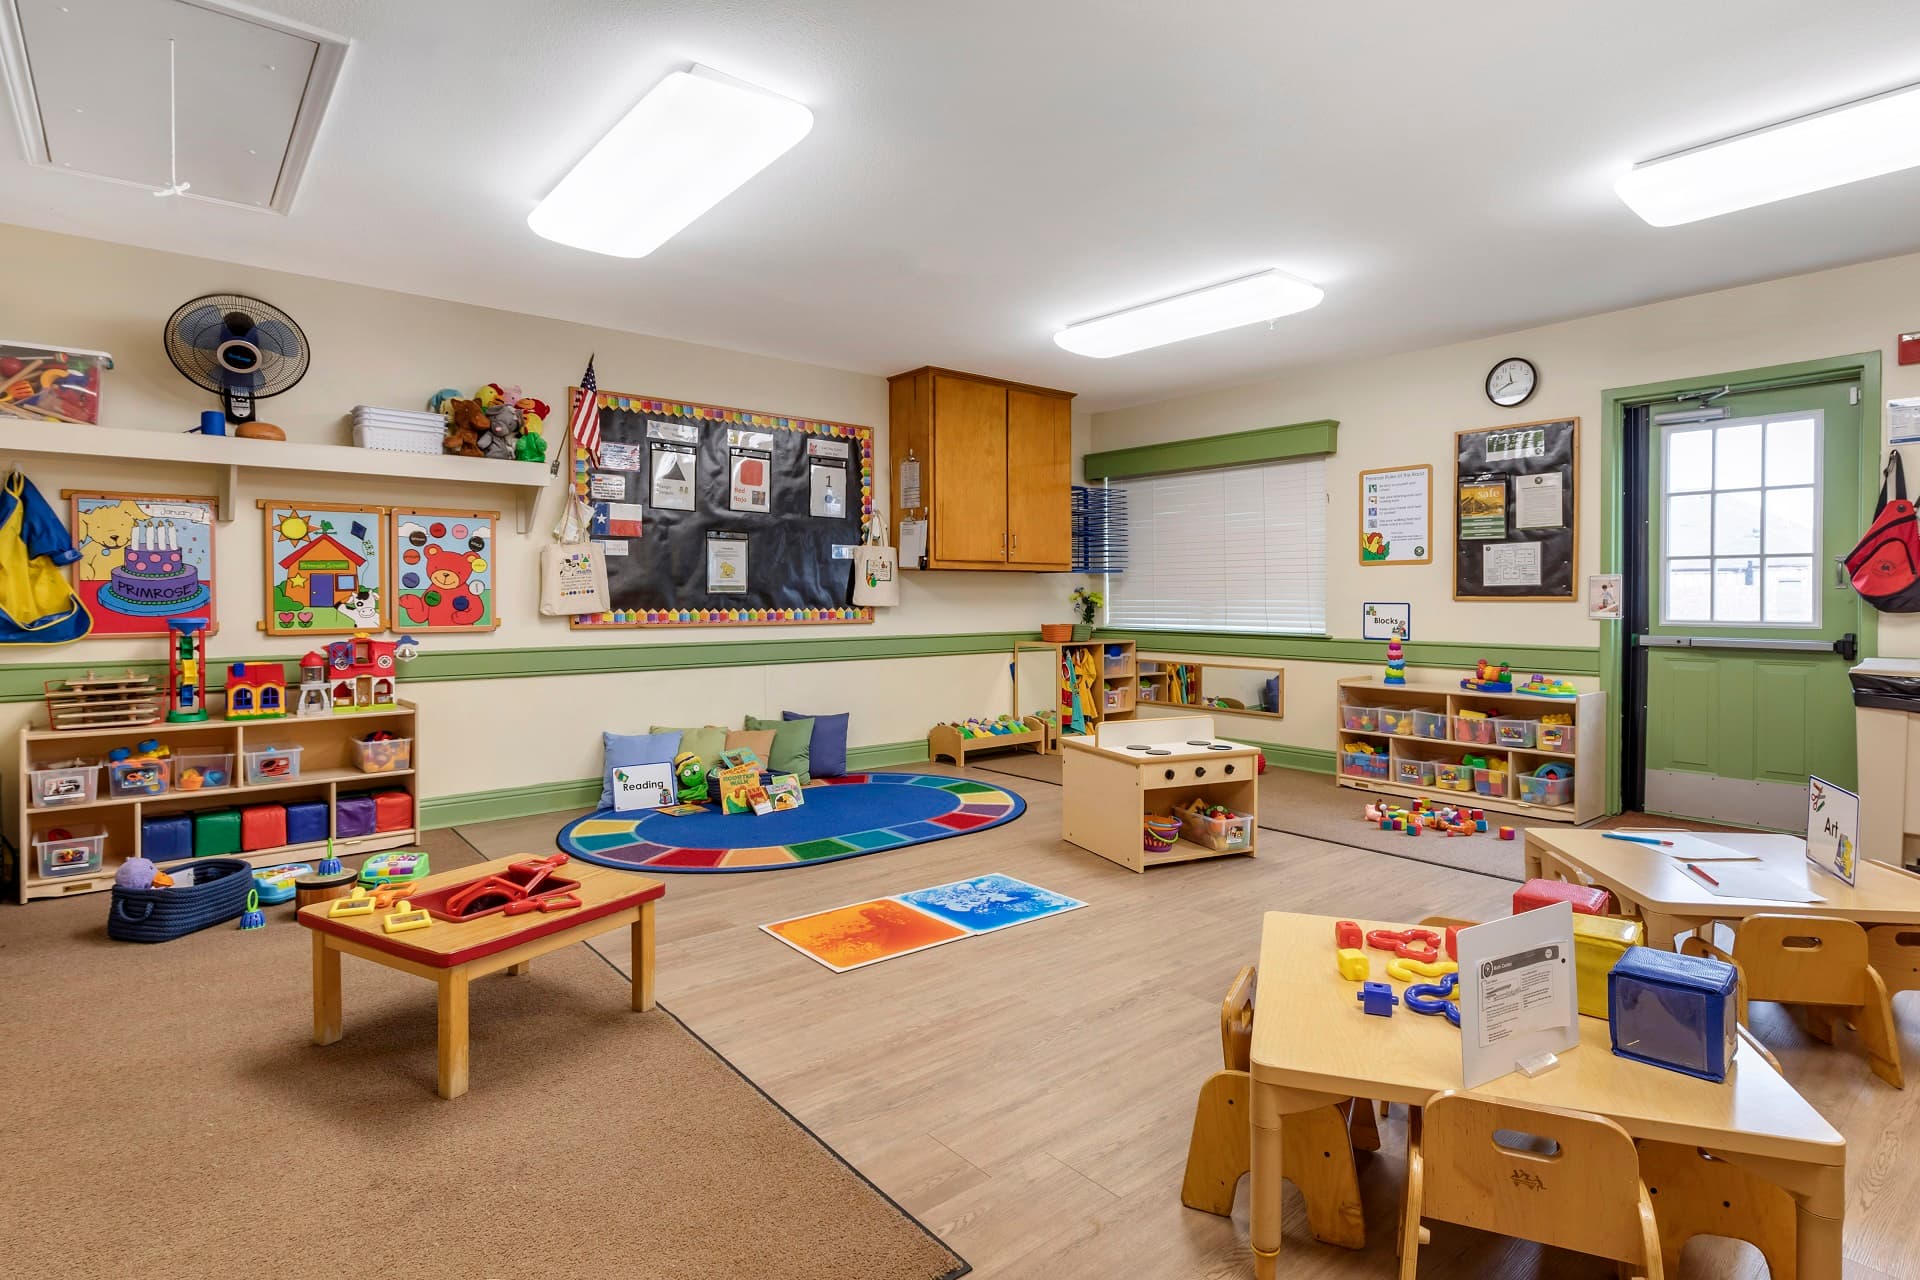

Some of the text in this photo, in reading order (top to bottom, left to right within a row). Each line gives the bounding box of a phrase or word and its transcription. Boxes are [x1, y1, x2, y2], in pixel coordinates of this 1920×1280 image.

[825, 475, 832, 487] 1
[1478, 487, 1500, 498] safe
[160, 507, 195, 517] January
[118, 581, 193, 599] PRIMROSE
[1374, 617, 1399, 625] Blocks
[623, 781, 664, 791] Reading
[1824, 817, 1839, 838] Art
